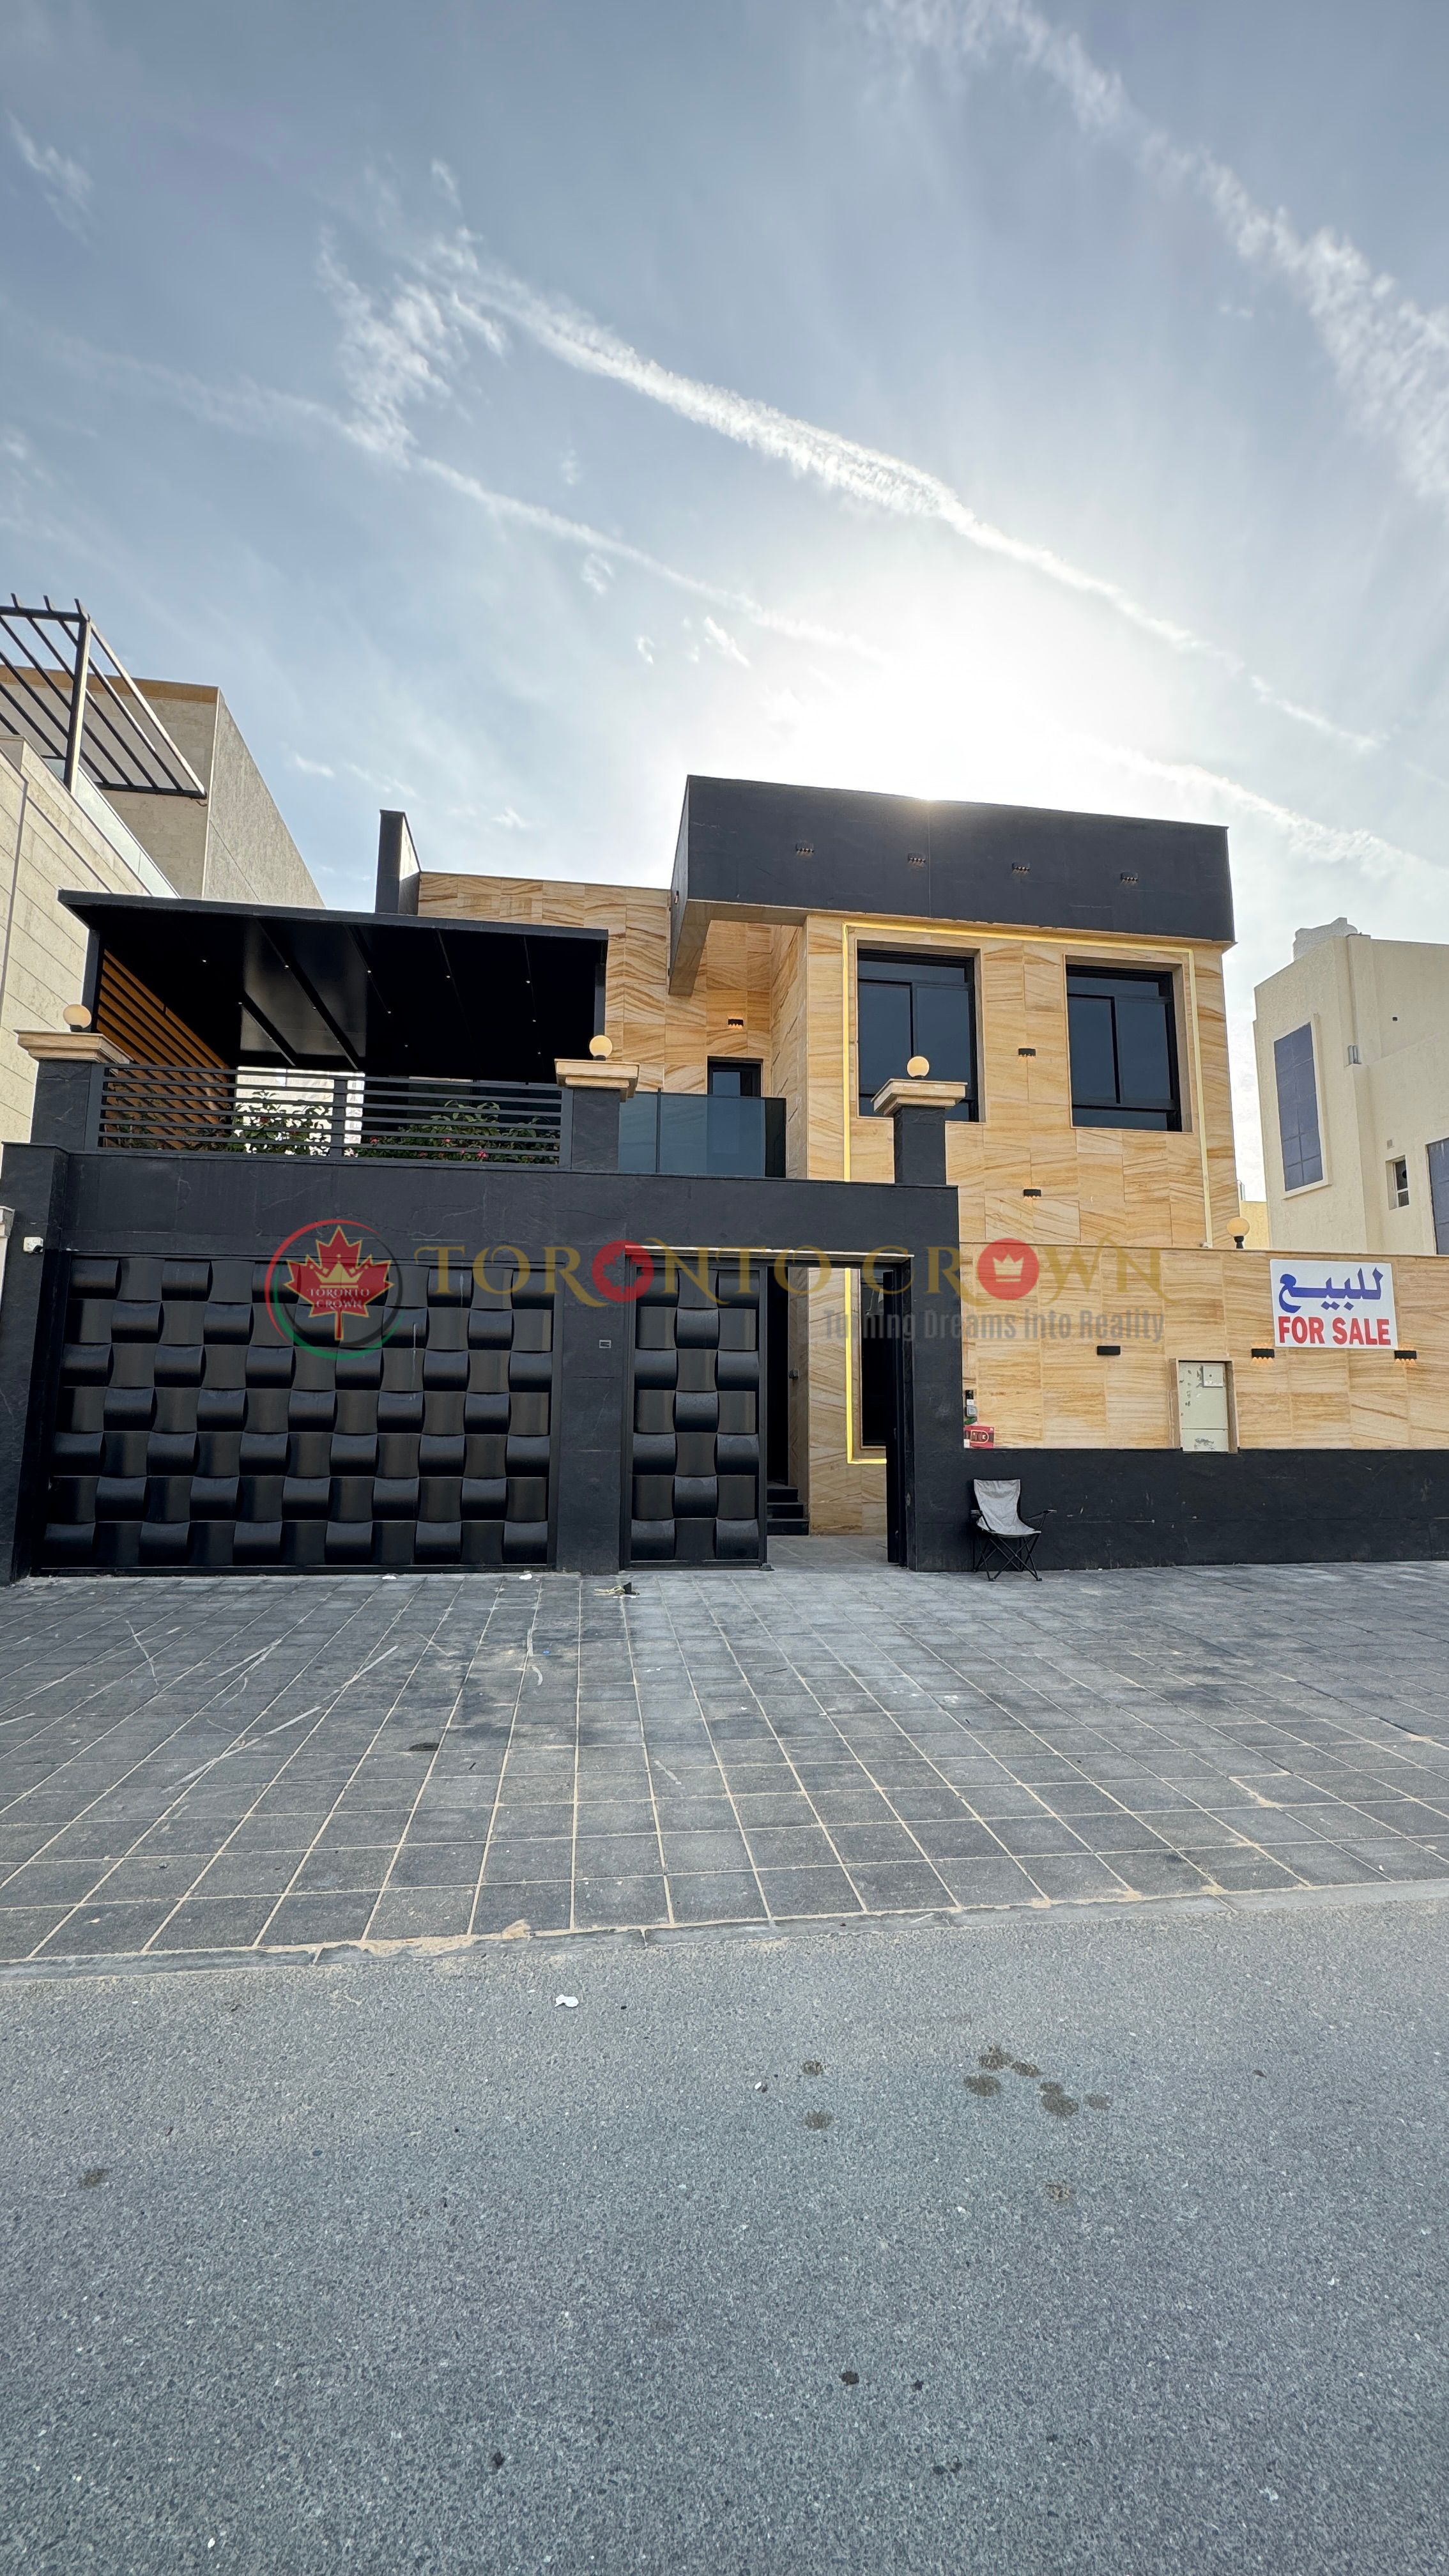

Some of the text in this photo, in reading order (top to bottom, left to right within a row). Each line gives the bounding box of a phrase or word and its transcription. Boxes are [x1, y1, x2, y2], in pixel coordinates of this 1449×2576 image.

[1278, 1268, 1383, 1314] للبيع
[1278, 1316, 1392, 1346] FOR SALE
